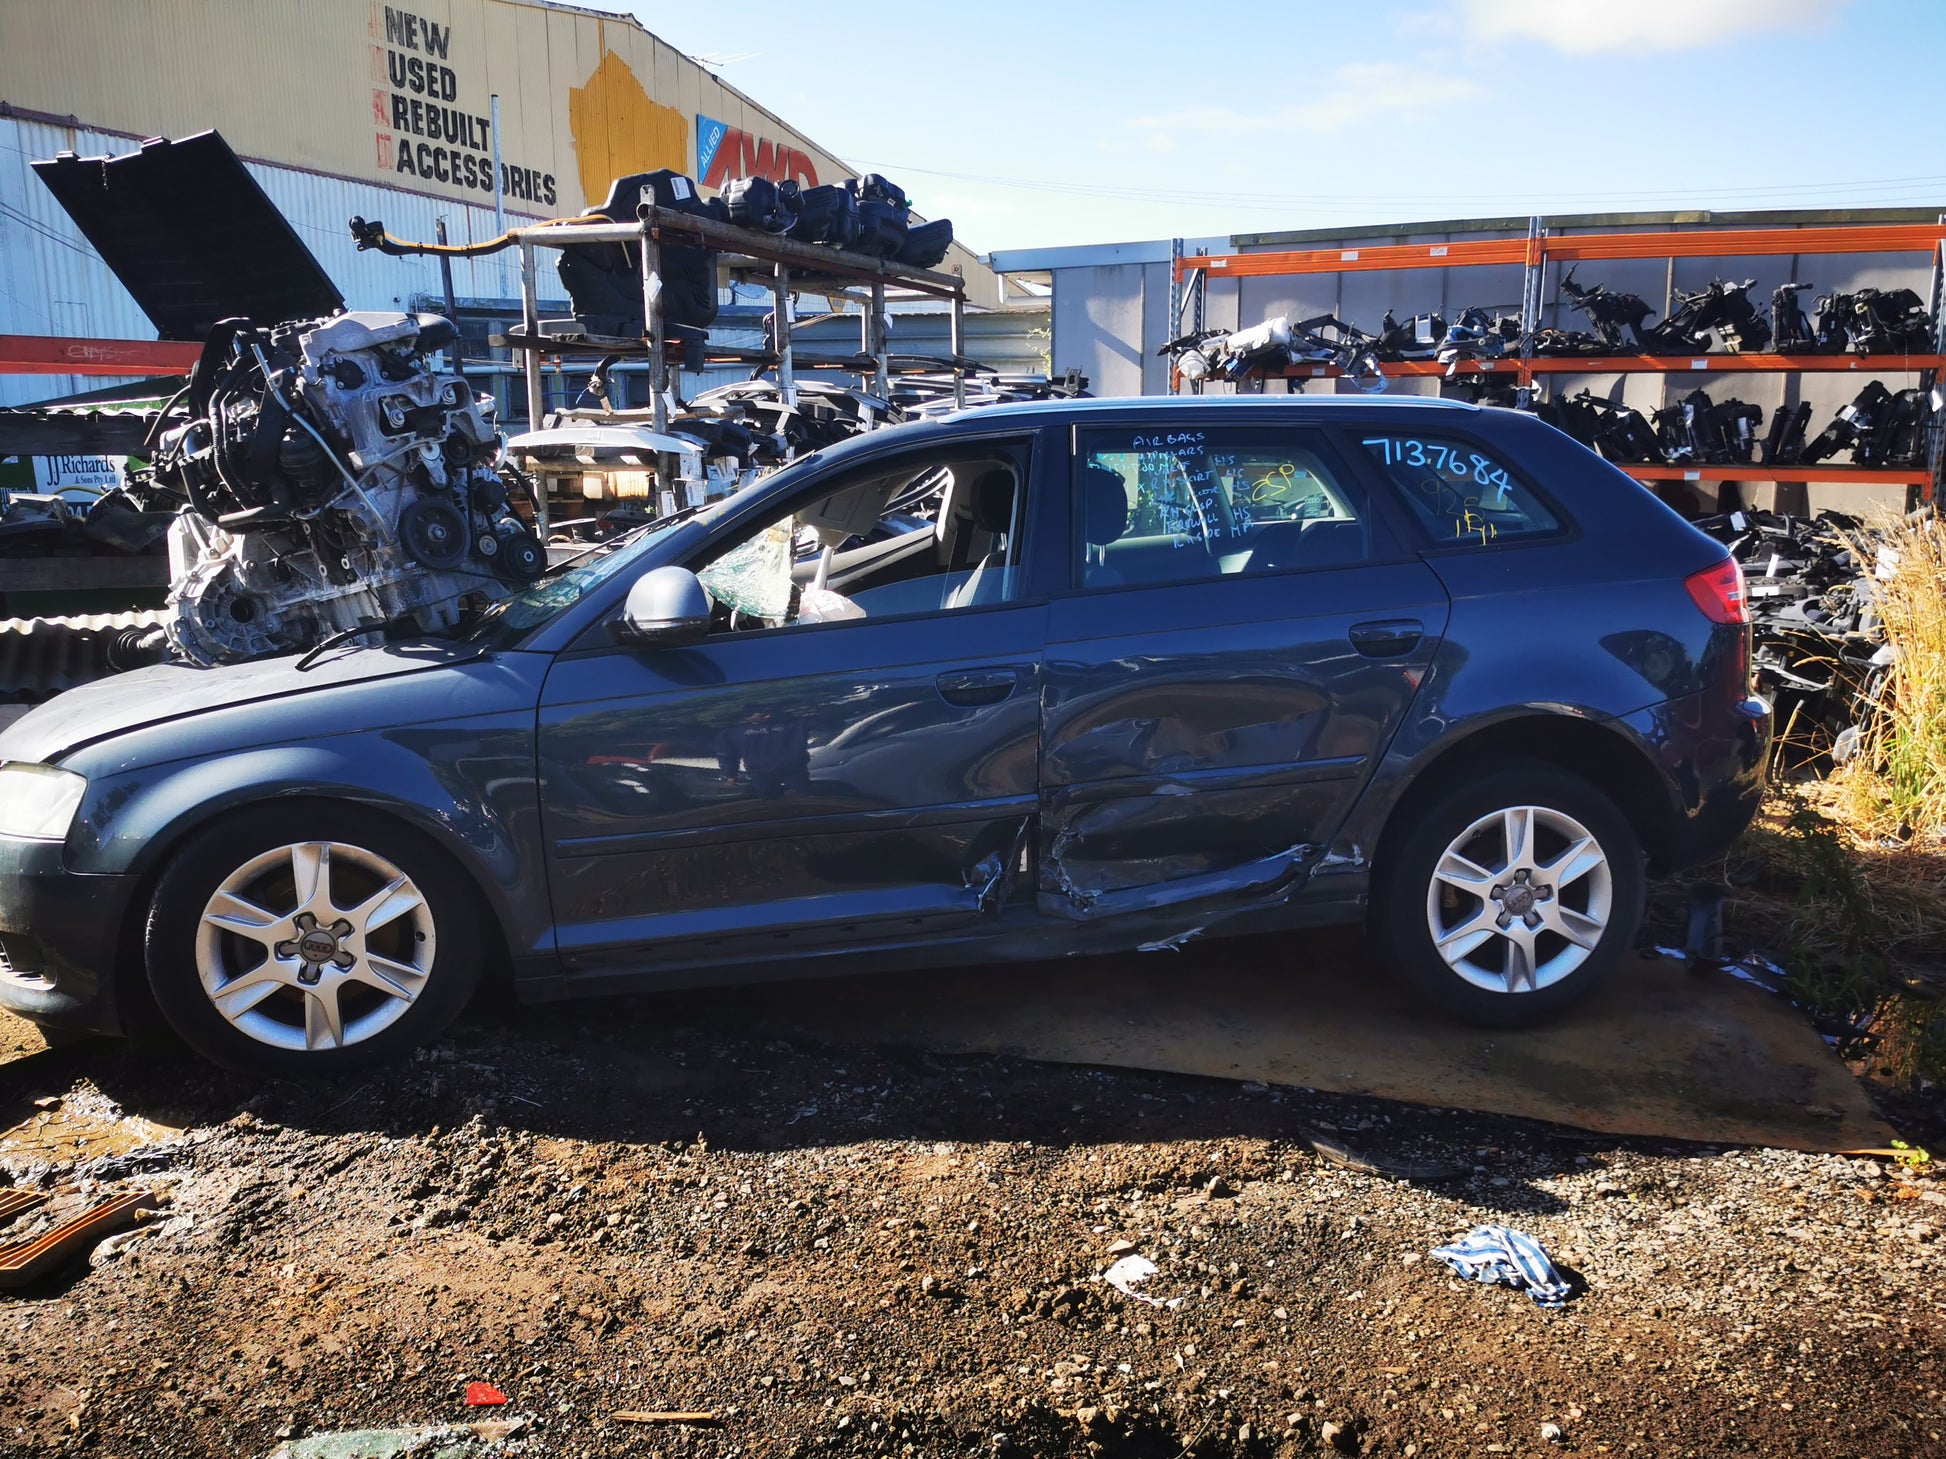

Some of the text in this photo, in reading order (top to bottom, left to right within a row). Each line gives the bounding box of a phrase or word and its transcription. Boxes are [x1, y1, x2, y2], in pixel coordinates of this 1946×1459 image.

[385, 5, 450, 60] NEW
[388, 50, 457, 102] USED
[391, 93, 490, 152] REBUILT
[700, 126, 720, 169] ALLIED
[1133, 432, 1205, 449] AIR BAGS
